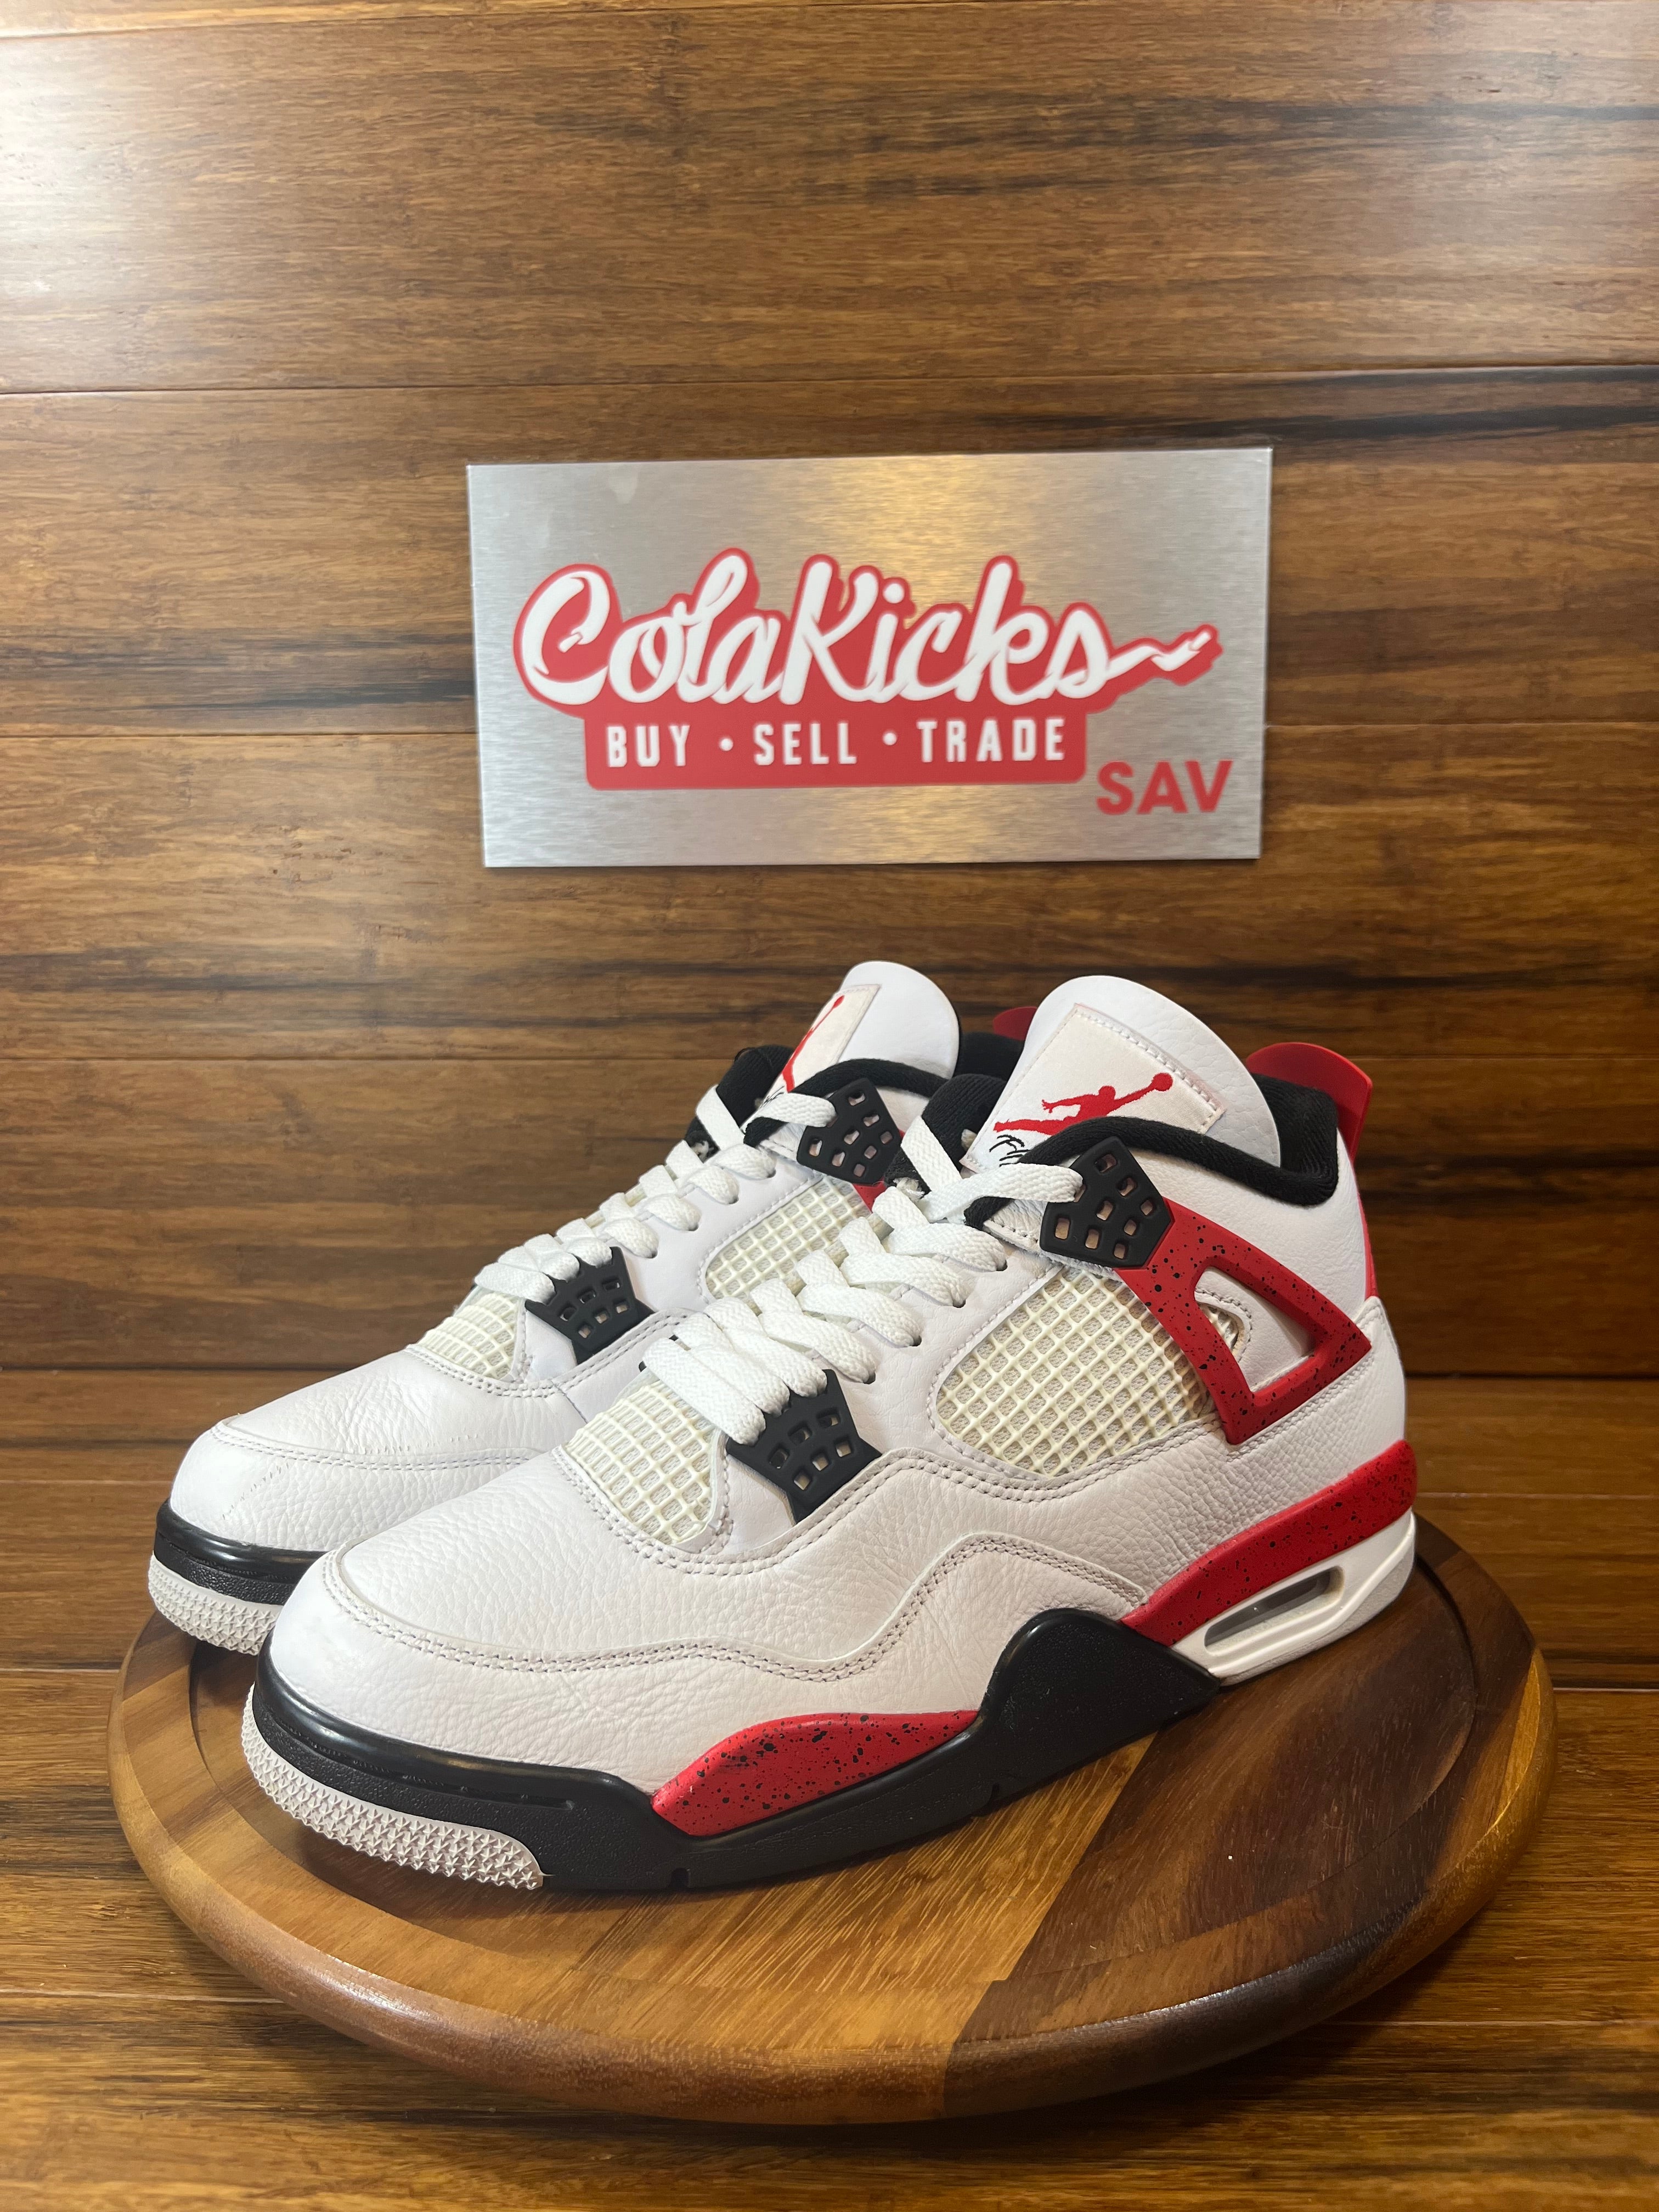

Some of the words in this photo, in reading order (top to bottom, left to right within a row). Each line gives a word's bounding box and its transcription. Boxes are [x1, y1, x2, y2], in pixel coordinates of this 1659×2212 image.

[519, 552, 1211, 706] ColaKicks
[606, 724, 691, 768] BUY
[753, 721, 857, 766] SELL
[917, 717, 1065, 763] TRADE
[1096, 760, 1233, 815] SAV
